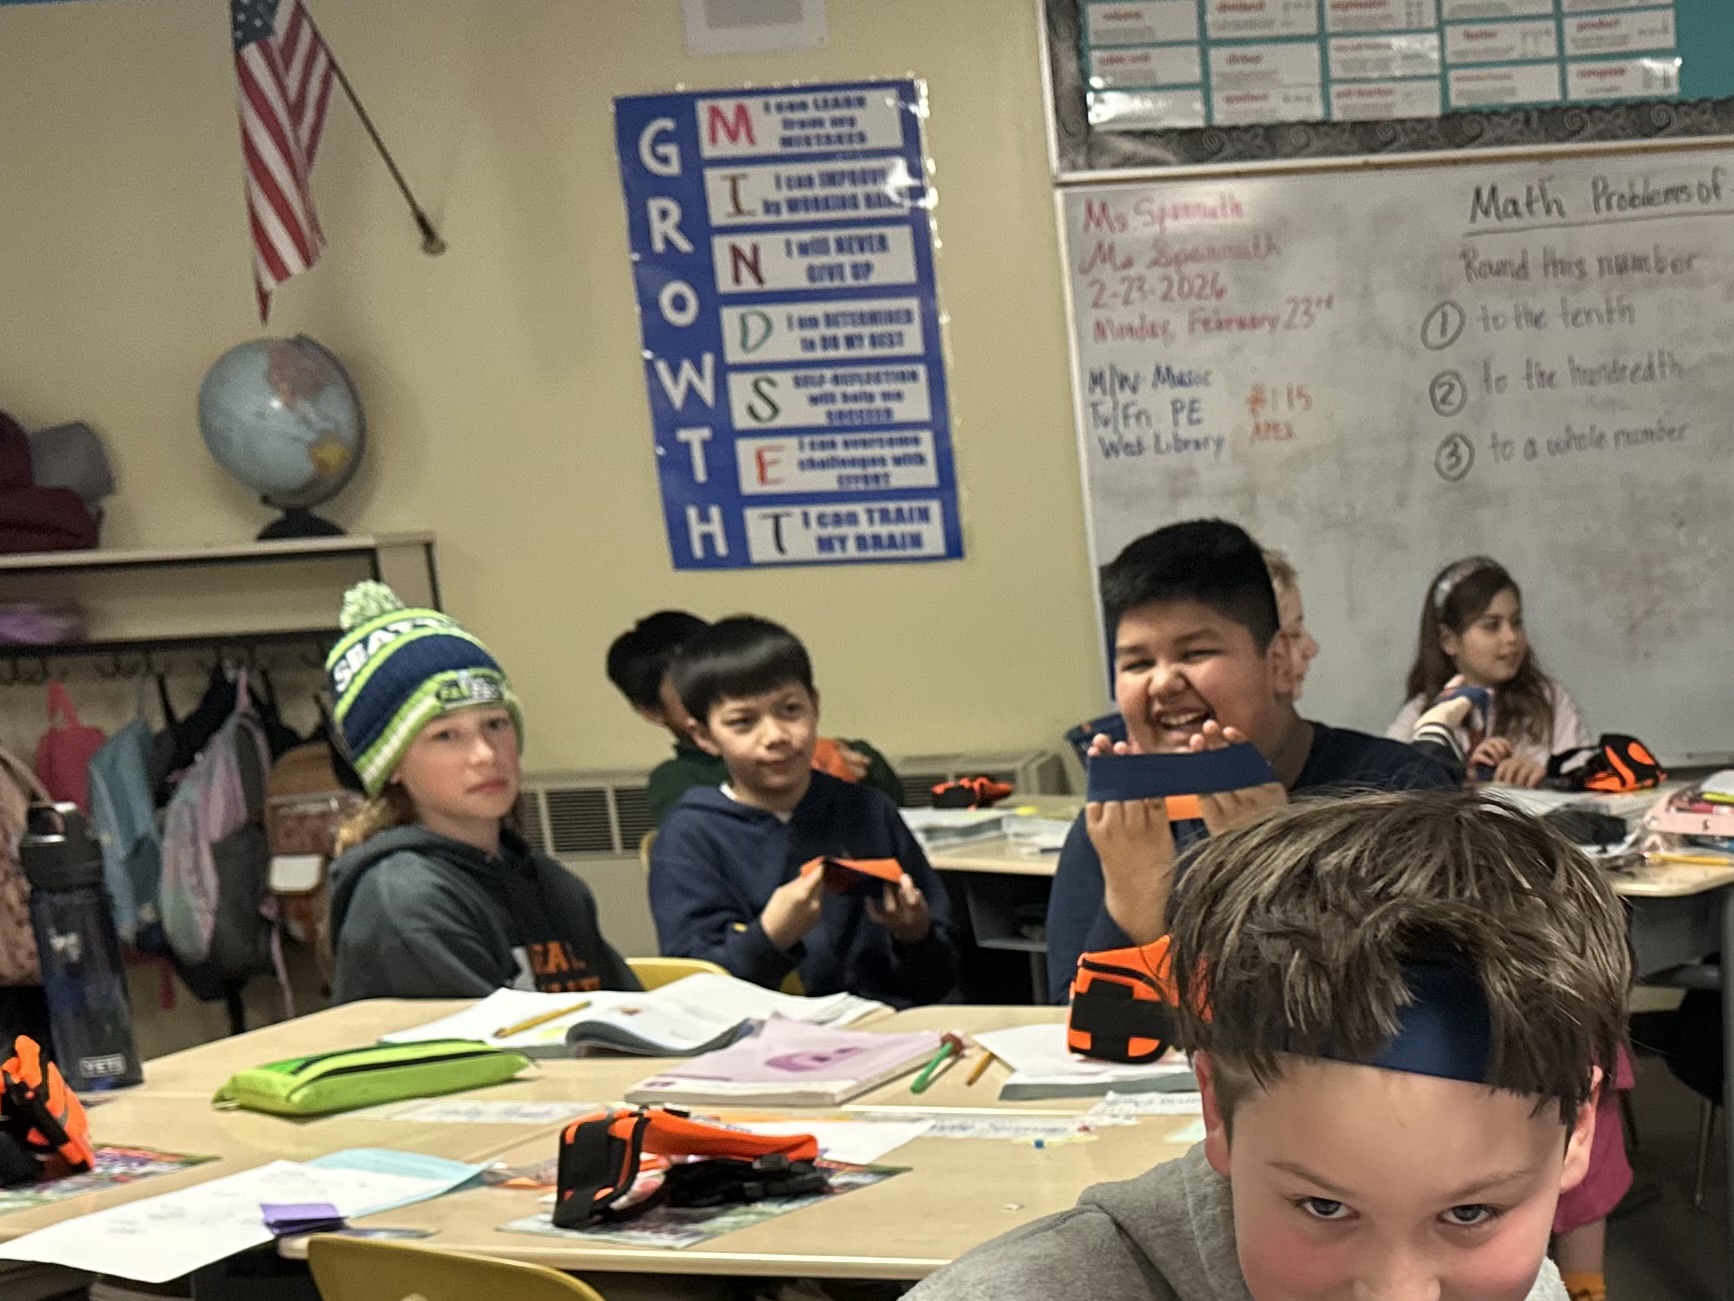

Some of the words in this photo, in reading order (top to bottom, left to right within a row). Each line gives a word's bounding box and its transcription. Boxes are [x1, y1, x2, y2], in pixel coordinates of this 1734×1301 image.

[1469, 175, 1565, 224] Math
[1591, 172, 1692, 214] Problems
[1695, 165, 1727, 200] of
[1461, 246, 1530, 283] Round
[1598, 243, 1697, 277] number
[1481, 305, 1506, 332] to
[1513, 299, 1547, 329] the
[1561, 296, 1636, 328] tenth
[1483, 361, 1507, 393] to
[1525, 356, 1557, 390] the
[1171, 399, 1202, 428] PE
[1490, 432, 1515, 464] to
[1522, 442, 1538, 462] a
[1546, 426, 1608, 457] whole
[866, 506, 931, 526] TRAIN
[855, 533, 924, 553] BRAIN
[85, 1056, 123, 1072] YETI
